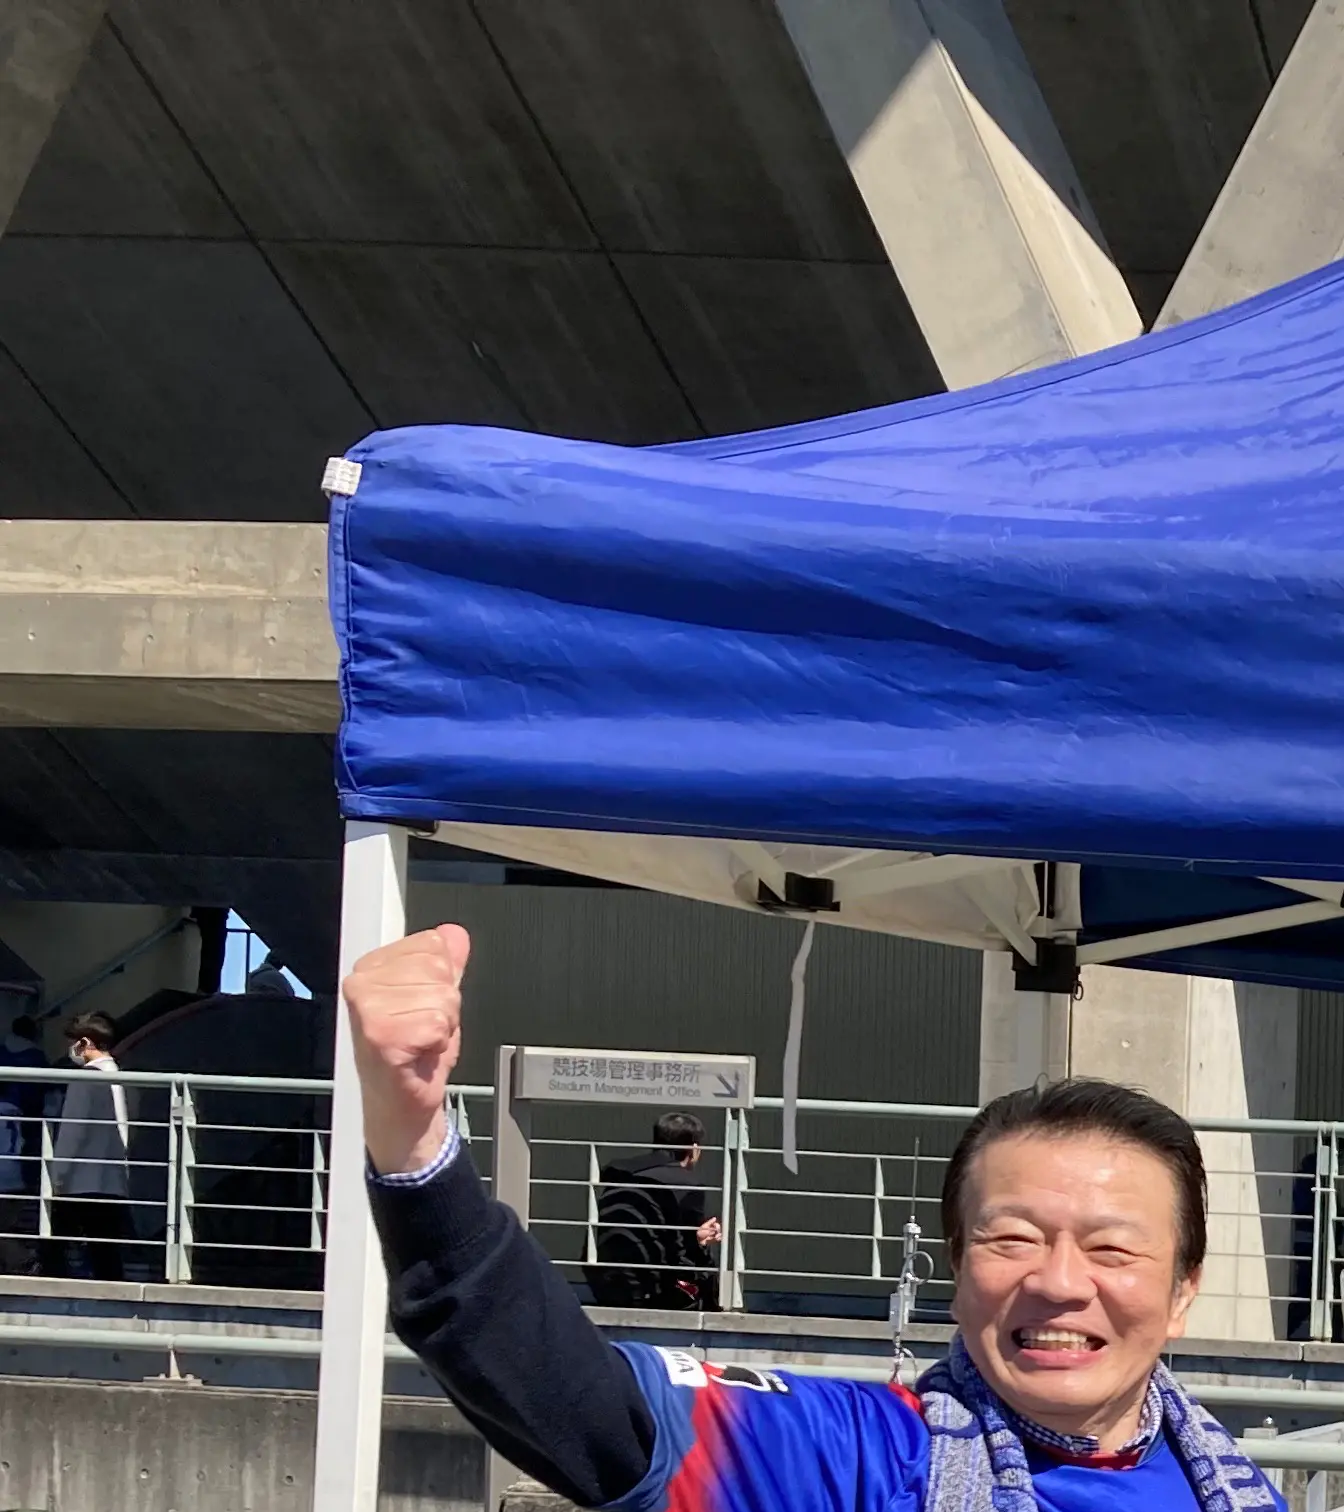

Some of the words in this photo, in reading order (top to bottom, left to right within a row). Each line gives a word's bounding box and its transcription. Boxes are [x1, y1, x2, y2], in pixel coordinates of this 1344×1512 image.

[552, 1057, 700, 1083] 競技場管理事務所
[548, 1079, 591, 1093] Stadium
[594, 1081, 663, 1097] Management
[667, 1085, 702, 1098] Office
